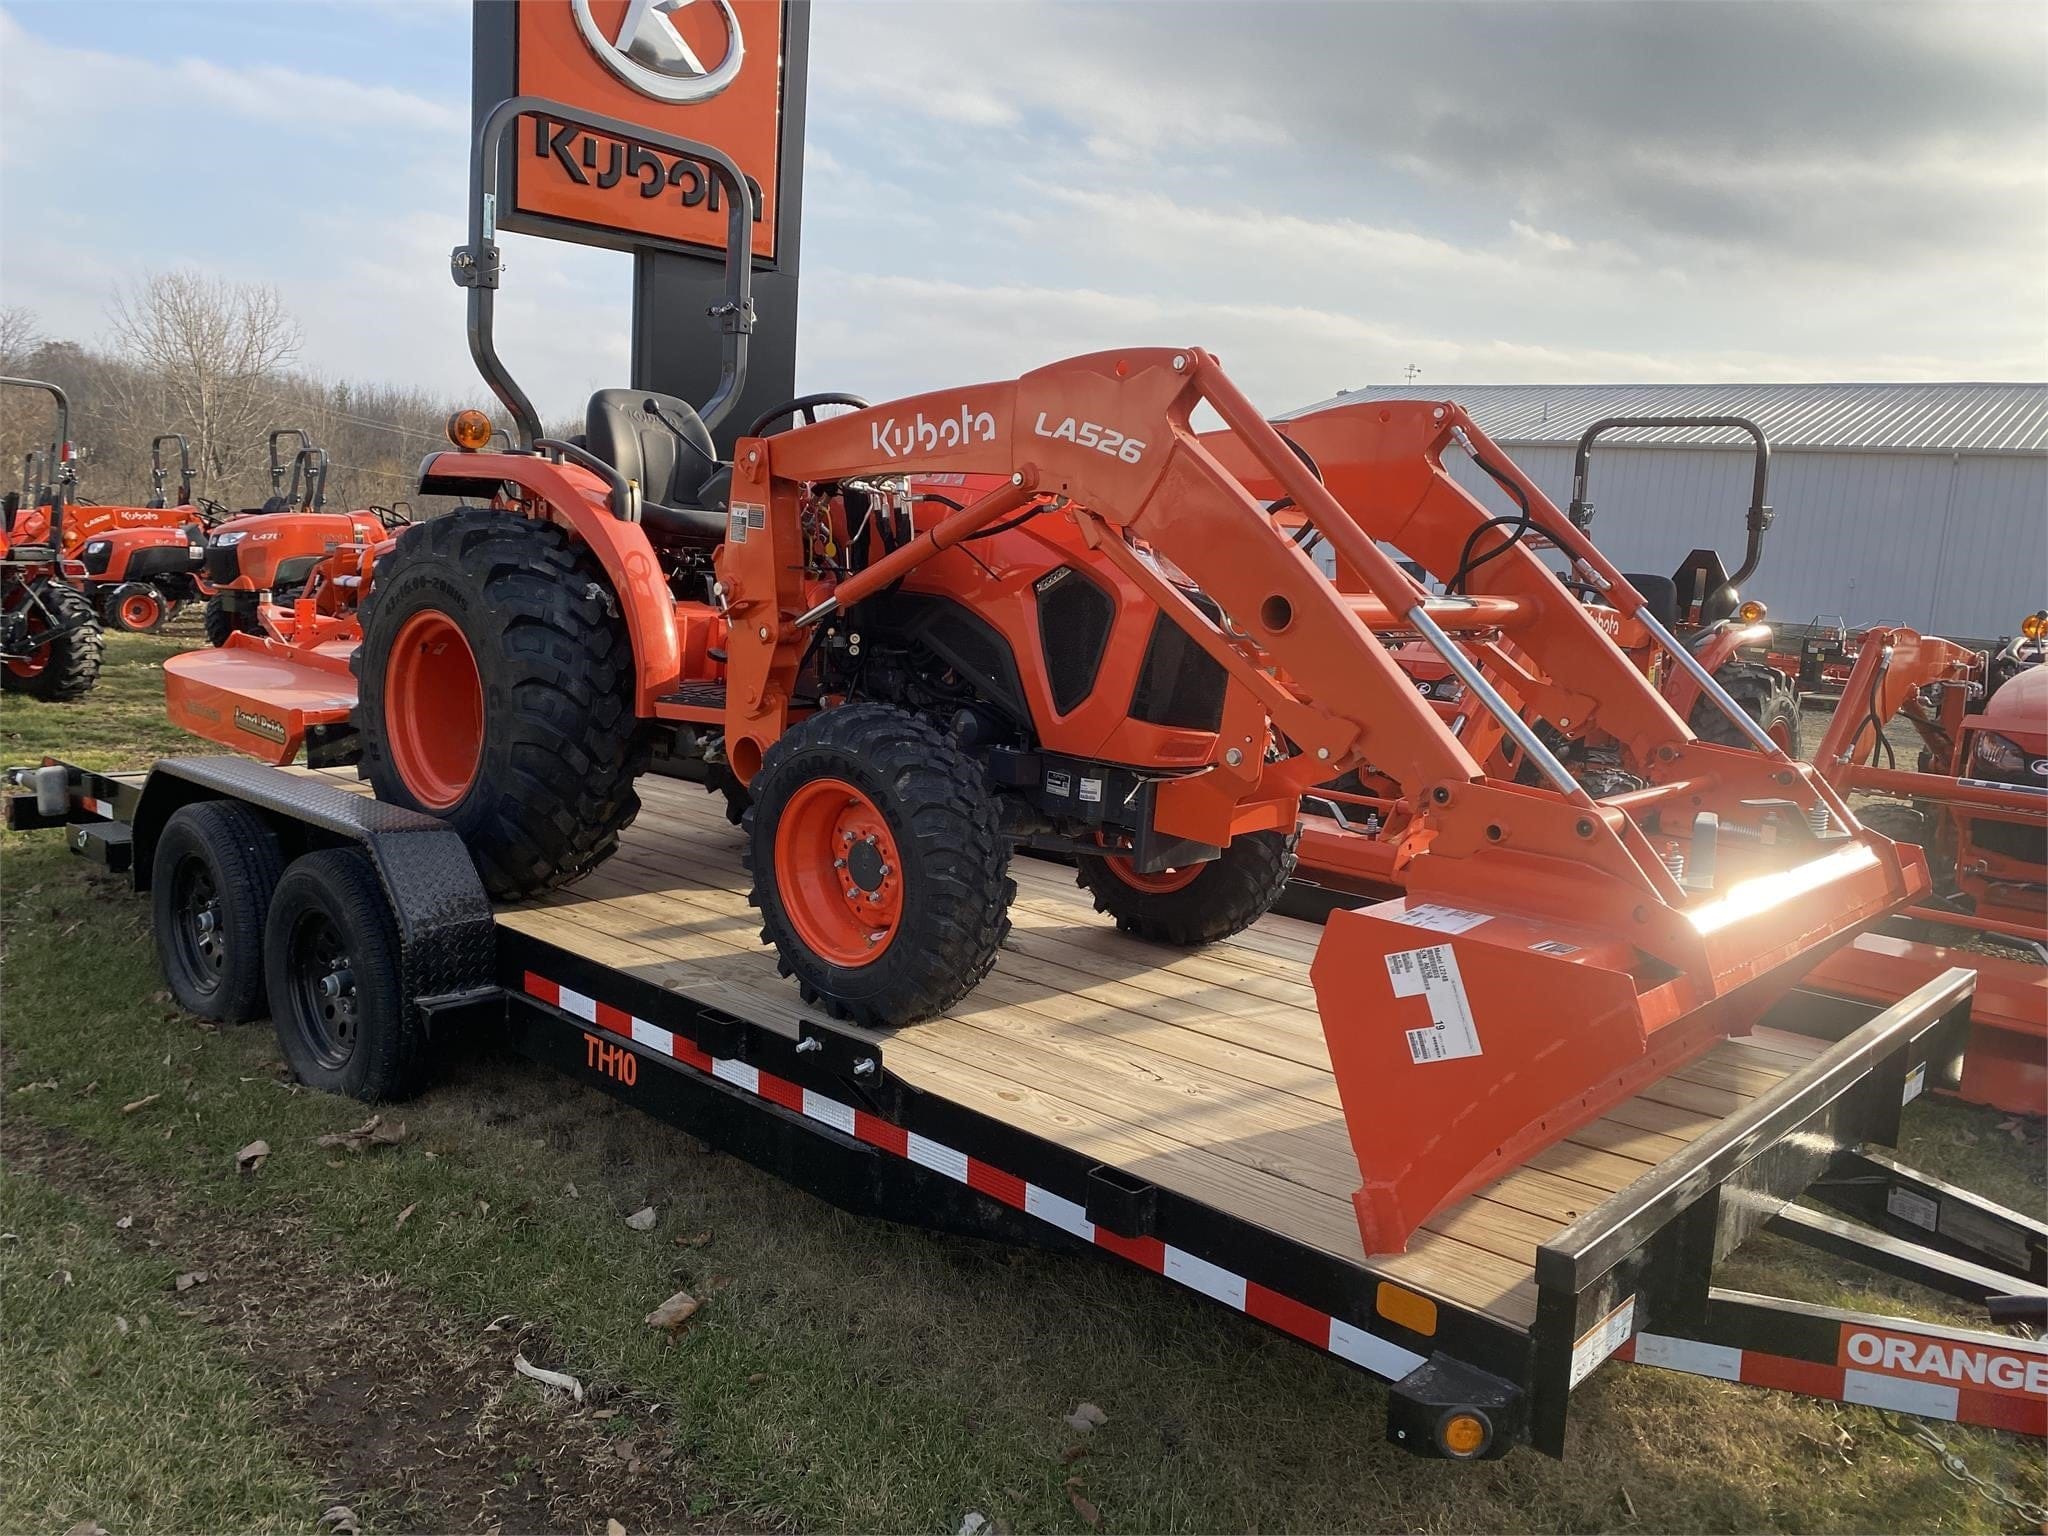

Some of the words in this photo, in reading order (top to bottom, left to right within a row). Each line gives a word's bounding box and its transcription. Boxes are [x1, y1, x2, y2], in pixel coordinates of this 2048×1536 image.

[871, 403, 996, 457] Kubota
[1034, 411, 1147, 464] LA526
[121, 511, 159, 521] Kubota
[1435, 1020, 1445, 1031] 19
[584, 1032, 637, 1087] TH10
[1847, 1333, 2048, 1395] ORANGE
